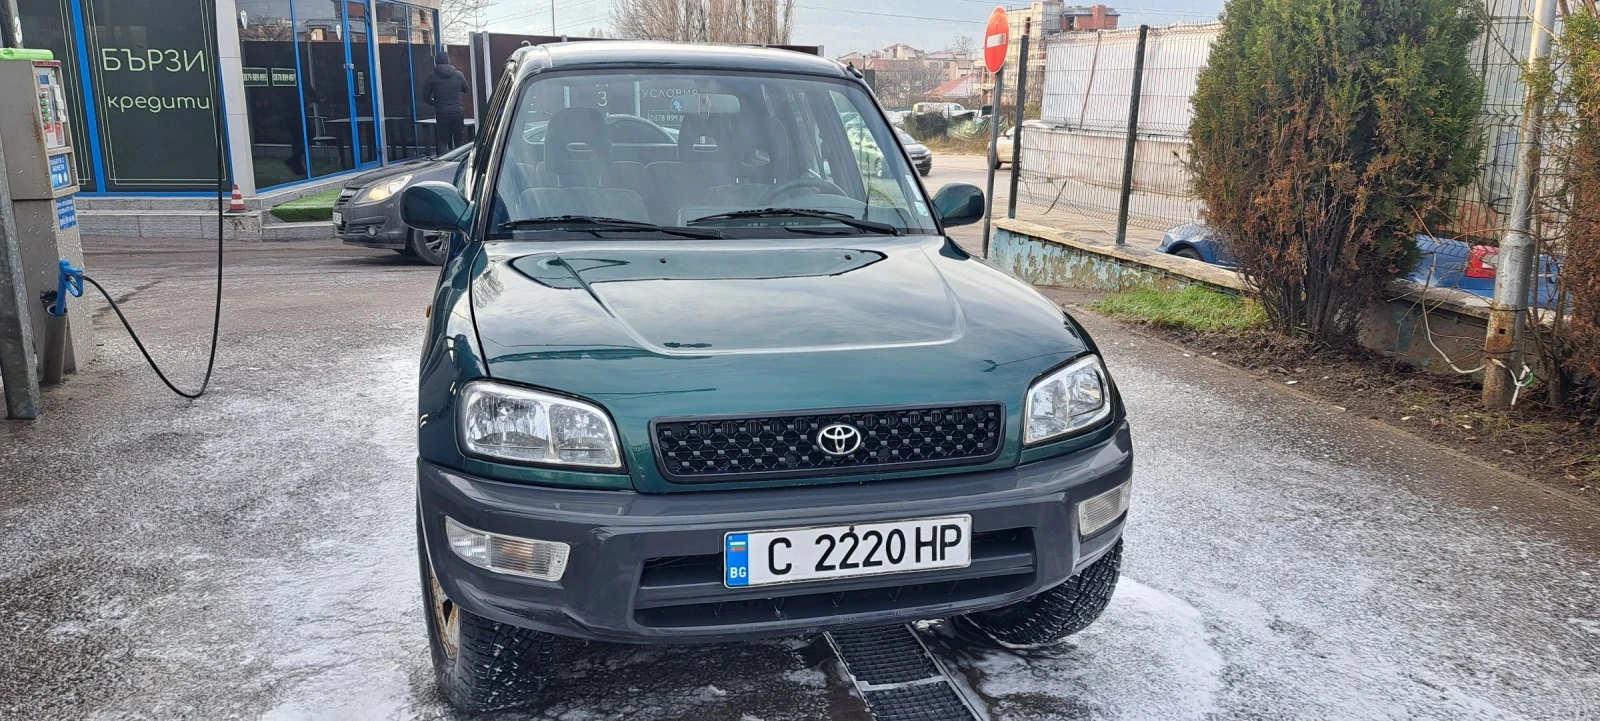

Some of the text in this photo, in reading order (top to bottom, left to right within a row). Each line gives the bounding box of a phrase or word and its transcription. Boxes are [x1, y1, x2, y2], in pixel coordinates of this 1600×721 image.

[102, 48, 205, 72] БЪРЗИ
[107, 95, 210, 113] кредити
[597, 91, 608, 107] 3
[768, 523, 962, 576] C 2220 HP
[730, 566, 747, 579] BG
